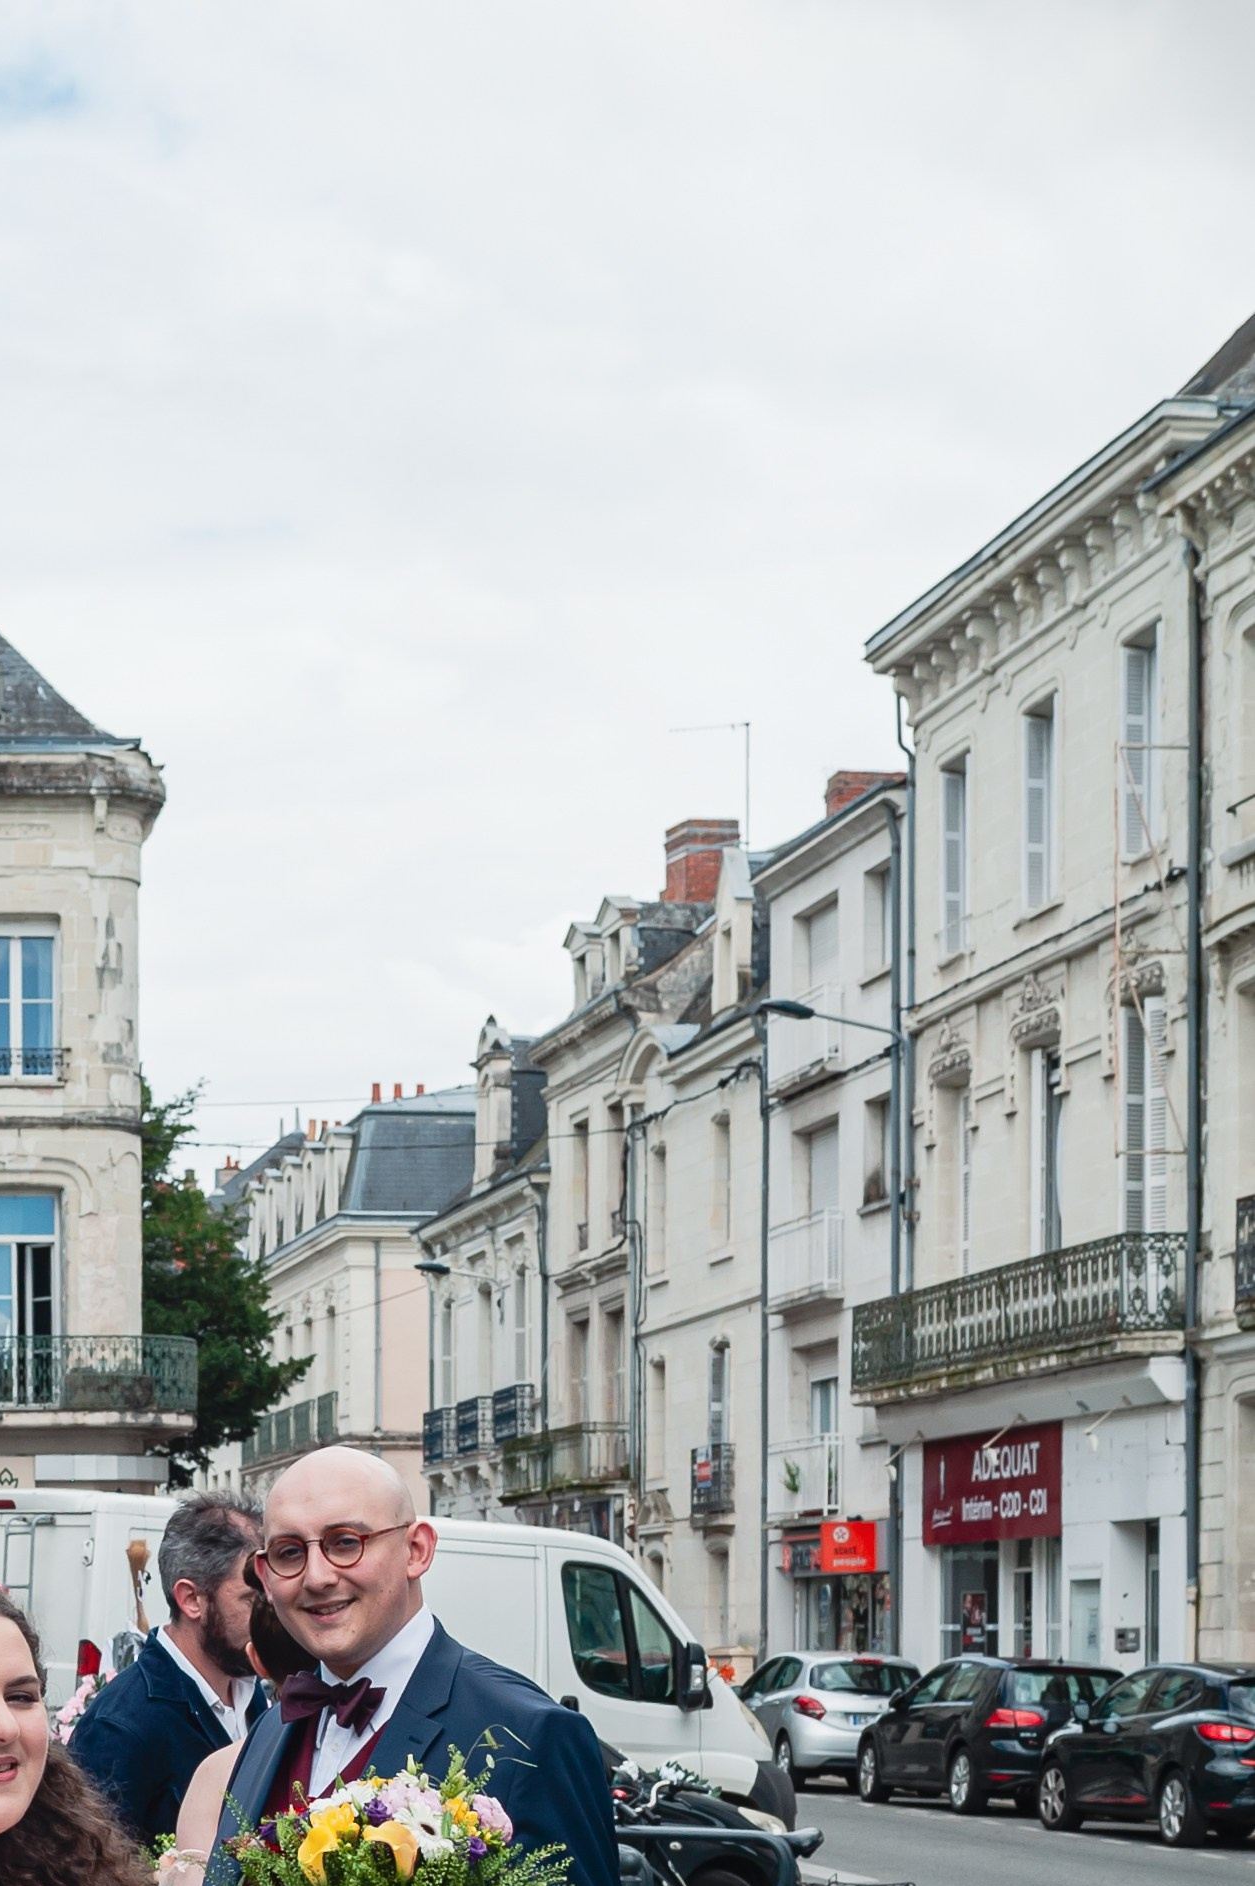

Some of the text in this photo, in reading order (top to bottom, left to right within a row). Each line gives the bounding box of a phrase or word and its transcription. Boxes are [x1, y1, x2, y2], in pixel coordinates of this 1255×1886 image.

[971, 1441, 1040, 1482] ADEQUAT
[961, 1496, 993, 1522] Intérim
[999, 1491, 1022, 1519] CDD
[1029, 1488, 1047, 1516] CDI
